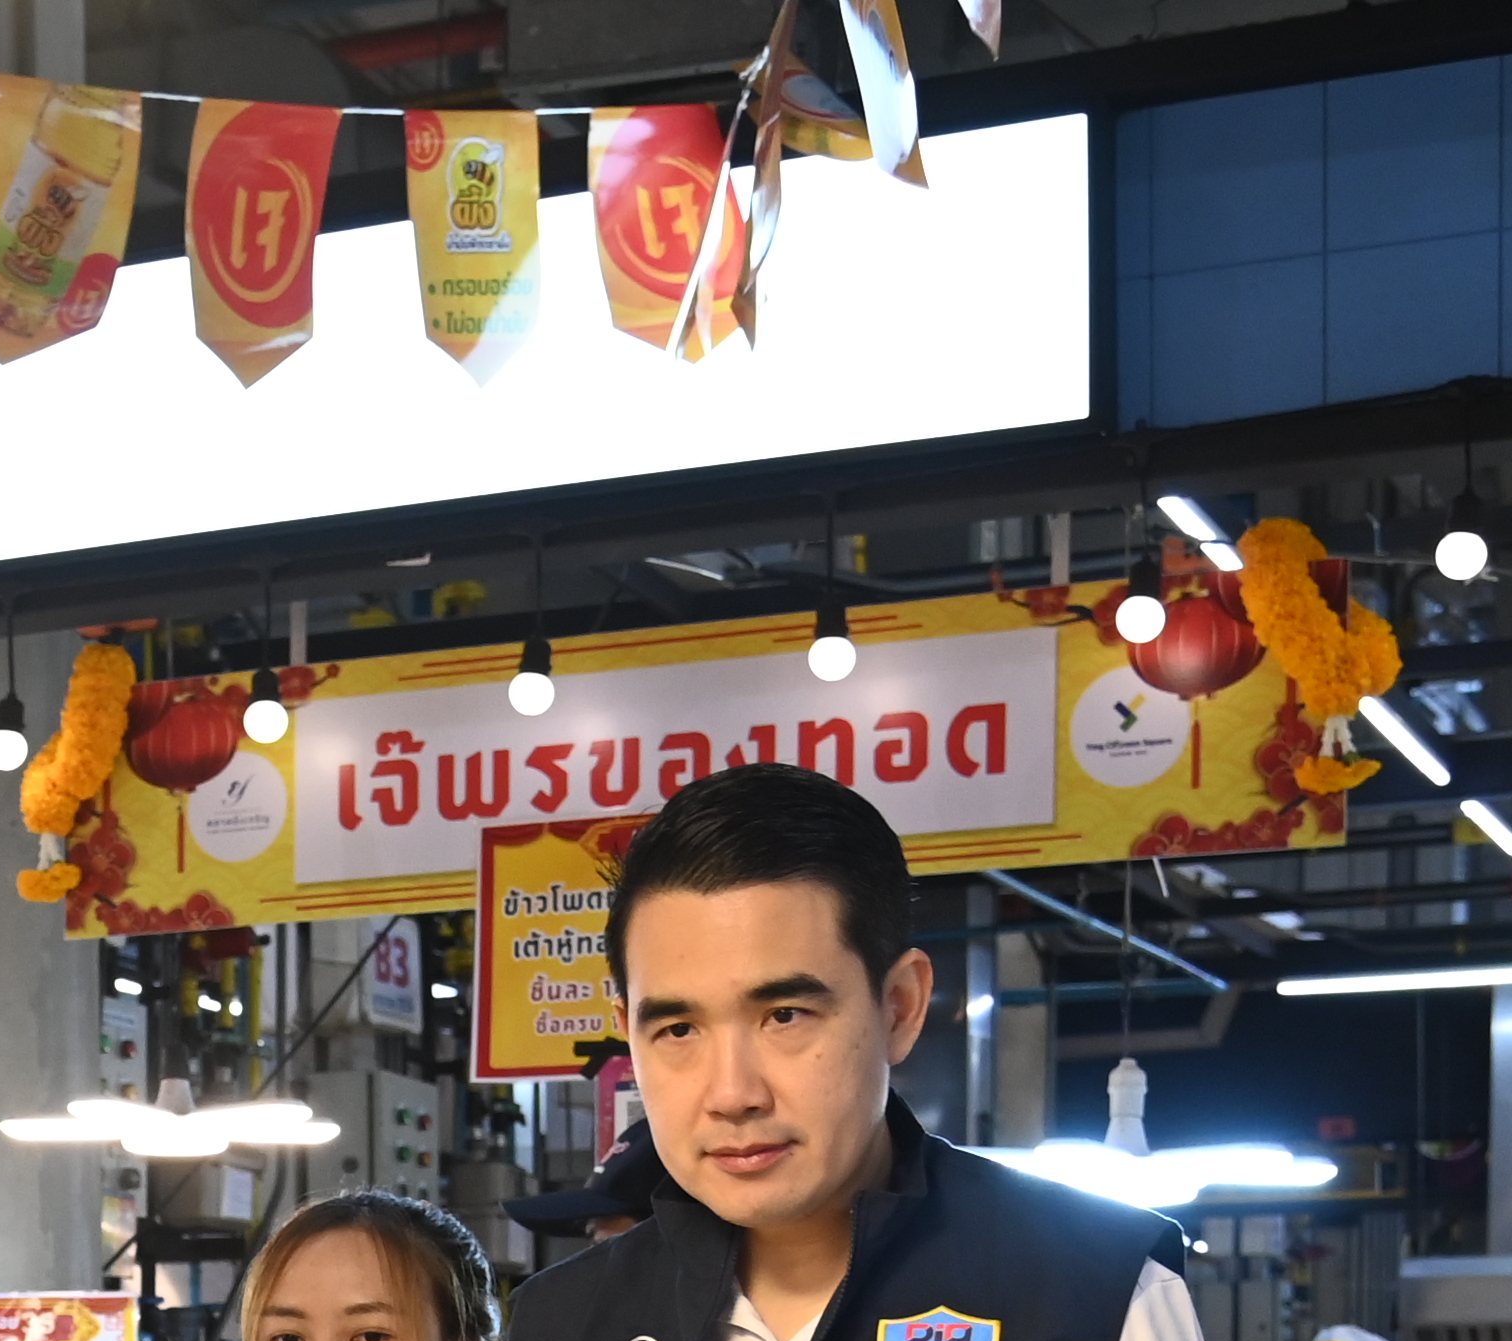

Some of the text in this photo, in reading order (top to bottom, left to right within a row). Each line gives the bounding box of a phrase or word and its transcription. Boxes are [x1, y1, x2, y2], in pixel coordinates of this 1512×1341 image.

[229, 185, 291, 274] เจ
[375, 933, 410, 988] B3
[513, 928, 608, 963] เต้าหู้ทอ
